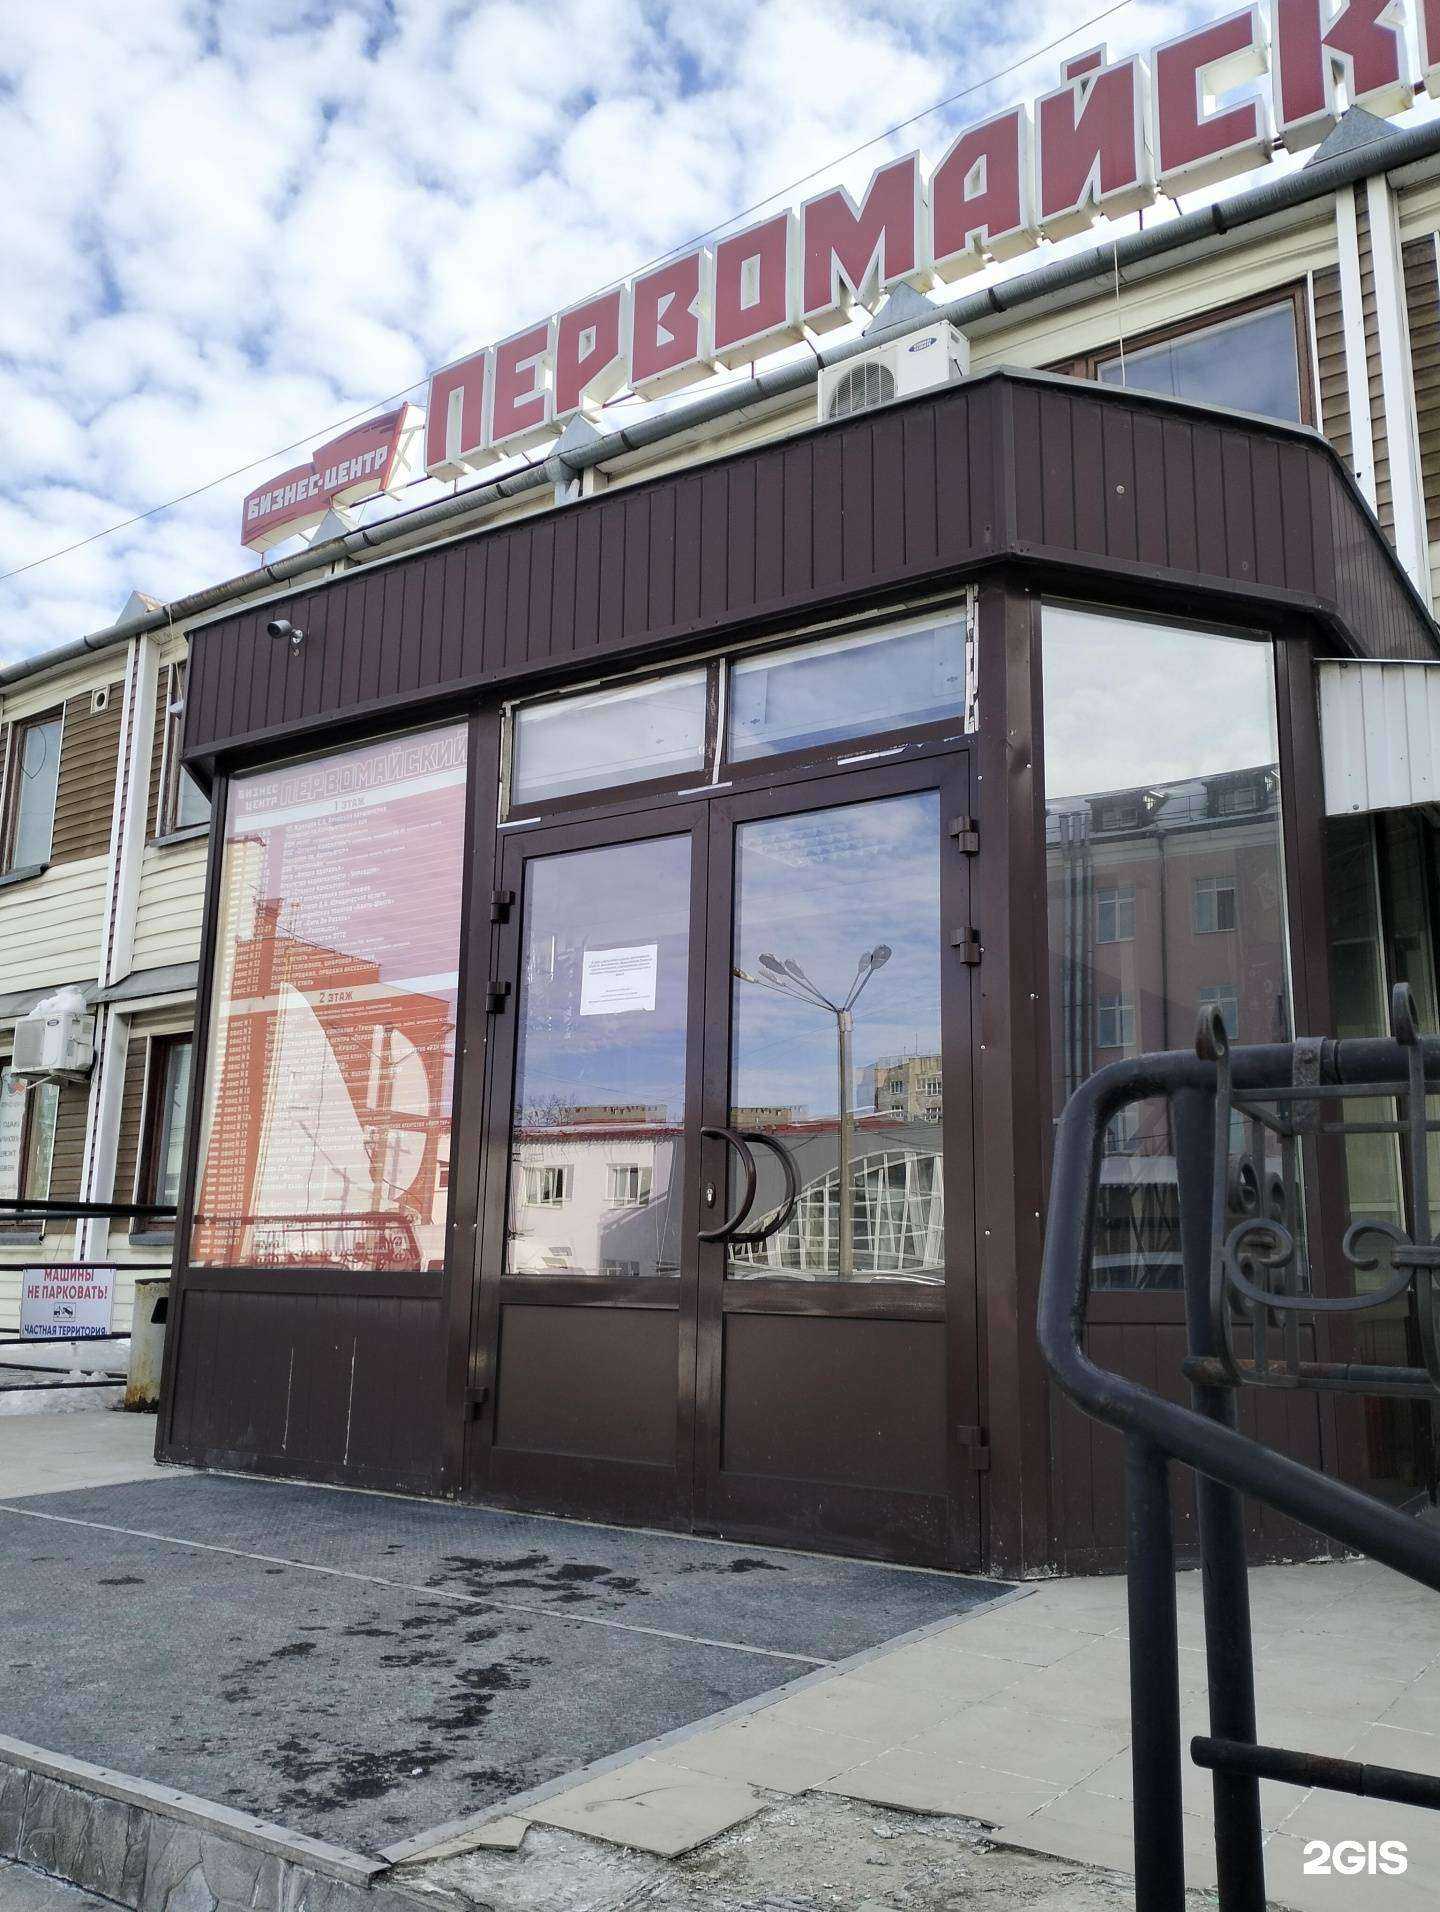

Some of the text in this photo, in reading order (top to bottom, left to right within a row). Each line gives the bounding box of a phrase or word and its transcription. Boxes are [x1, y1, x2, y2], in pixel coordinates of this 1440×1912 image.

[424, 0, 1440, 474] ПЕРВОМАЙСК
[247, 445, 388, 520] БИЗНЕС-ЦЕНТР
[280, 732, 467, 806] ПЕРВОМАЙСКИЙ
[238, 783, 279, 800] БИЗНЕС
[320, 991, 353, 1003] 2 ЭТАЖ
[43, 1268, 94, 1281] МАШИНЫ
[27, 1285, 108, 1300] НЕ ПАРКОВАТЬ!
[24, 1324, 57, 1335] ЧАСТНАЯ
